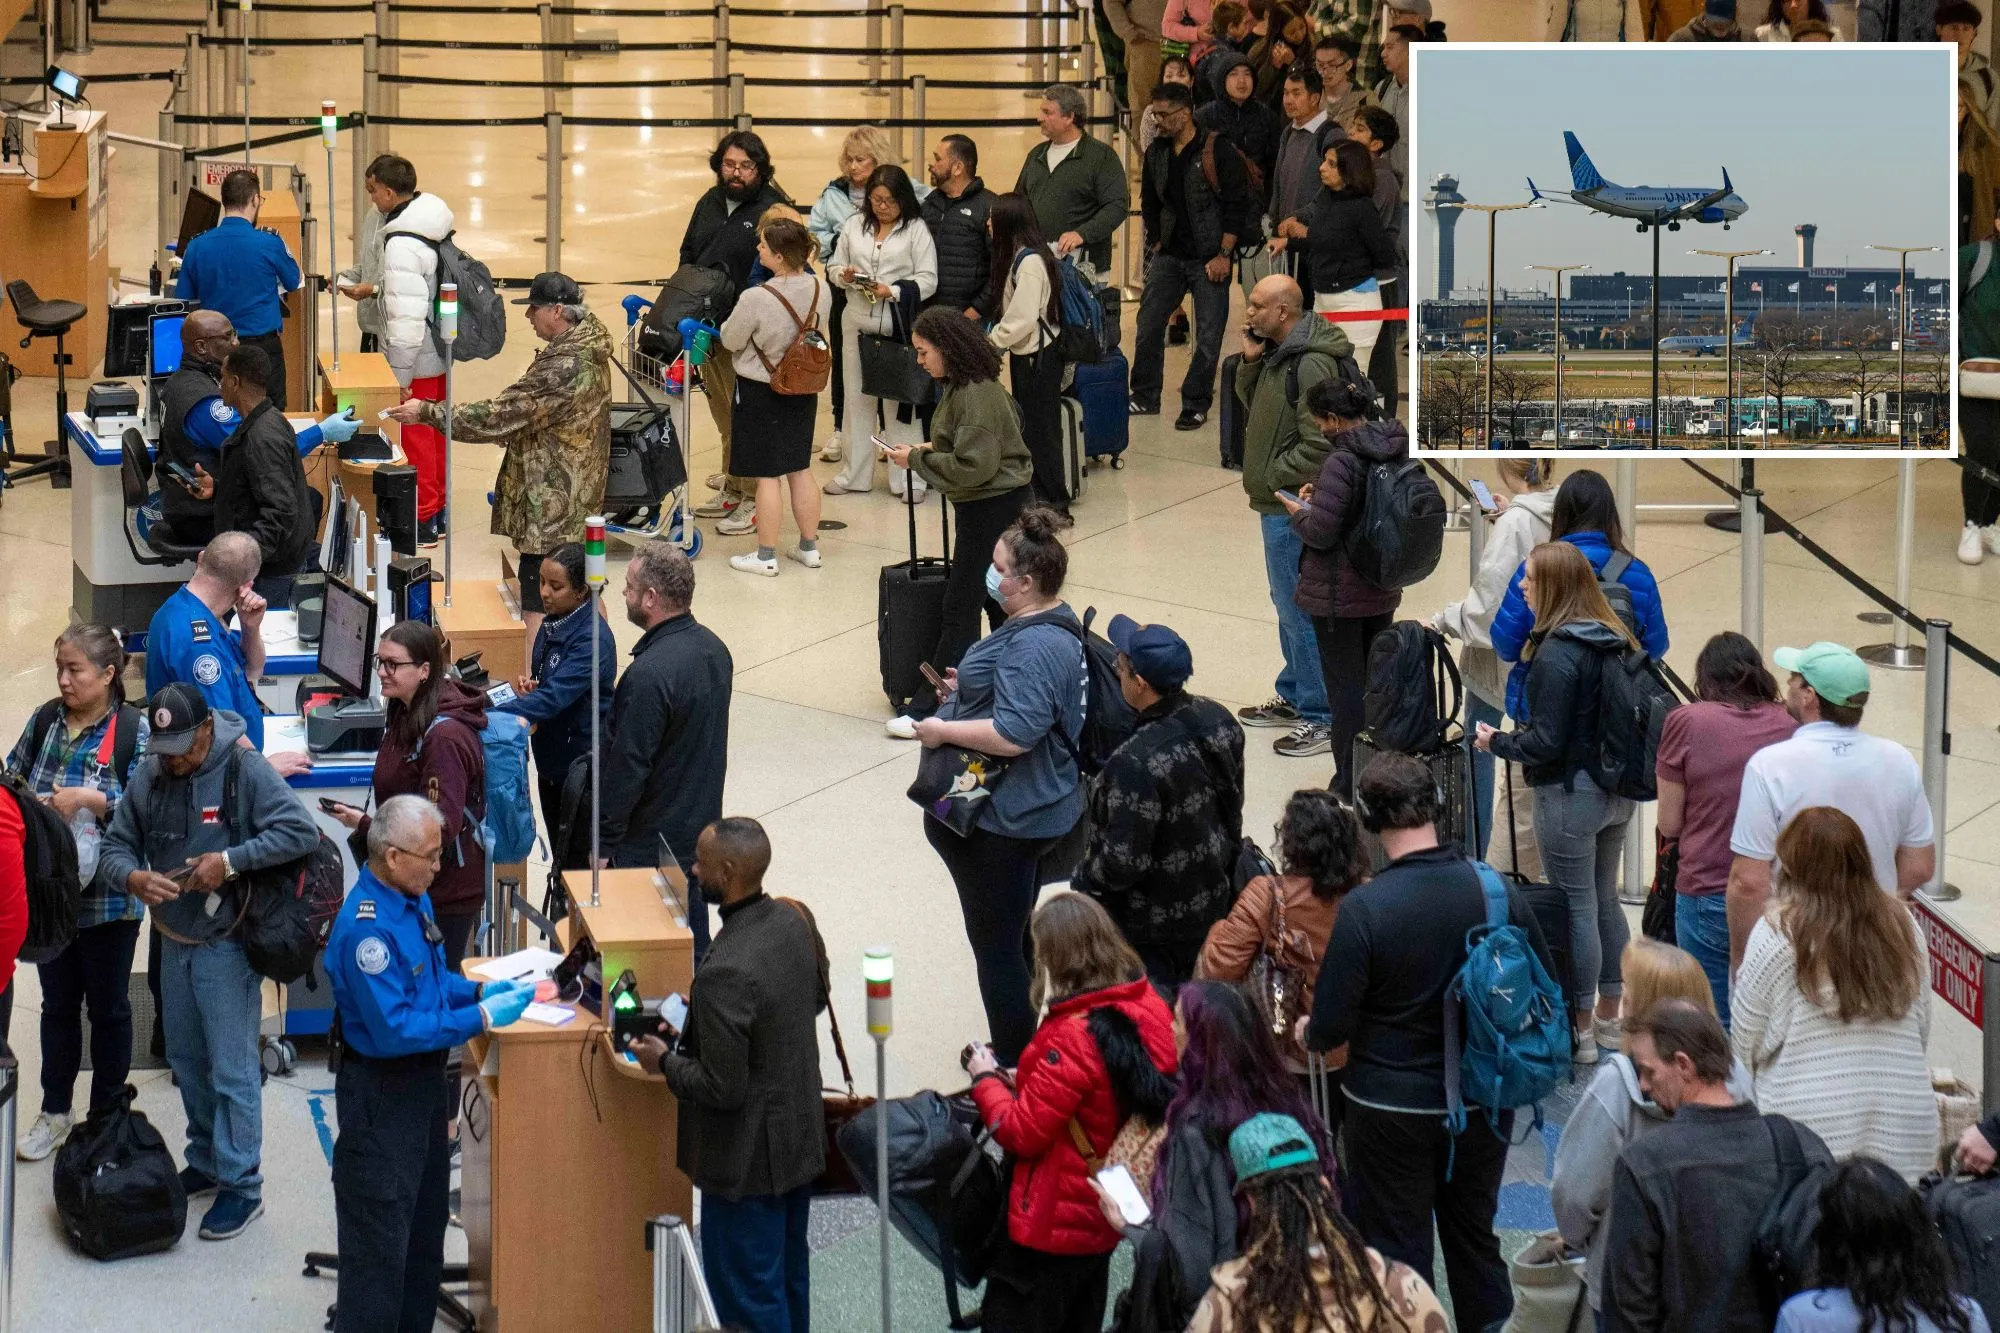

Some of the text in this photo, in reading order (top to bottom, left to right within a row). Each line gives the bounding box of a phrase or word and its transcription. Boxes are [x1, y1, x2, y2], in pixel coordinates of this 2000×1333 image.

[1664, 192, 1711, 203] UNITE
[1811, 267, 1845, 277] HILTON
[359, 904, 375, 912] TSA
[1945, 967, 1978, 1018] ONLY
